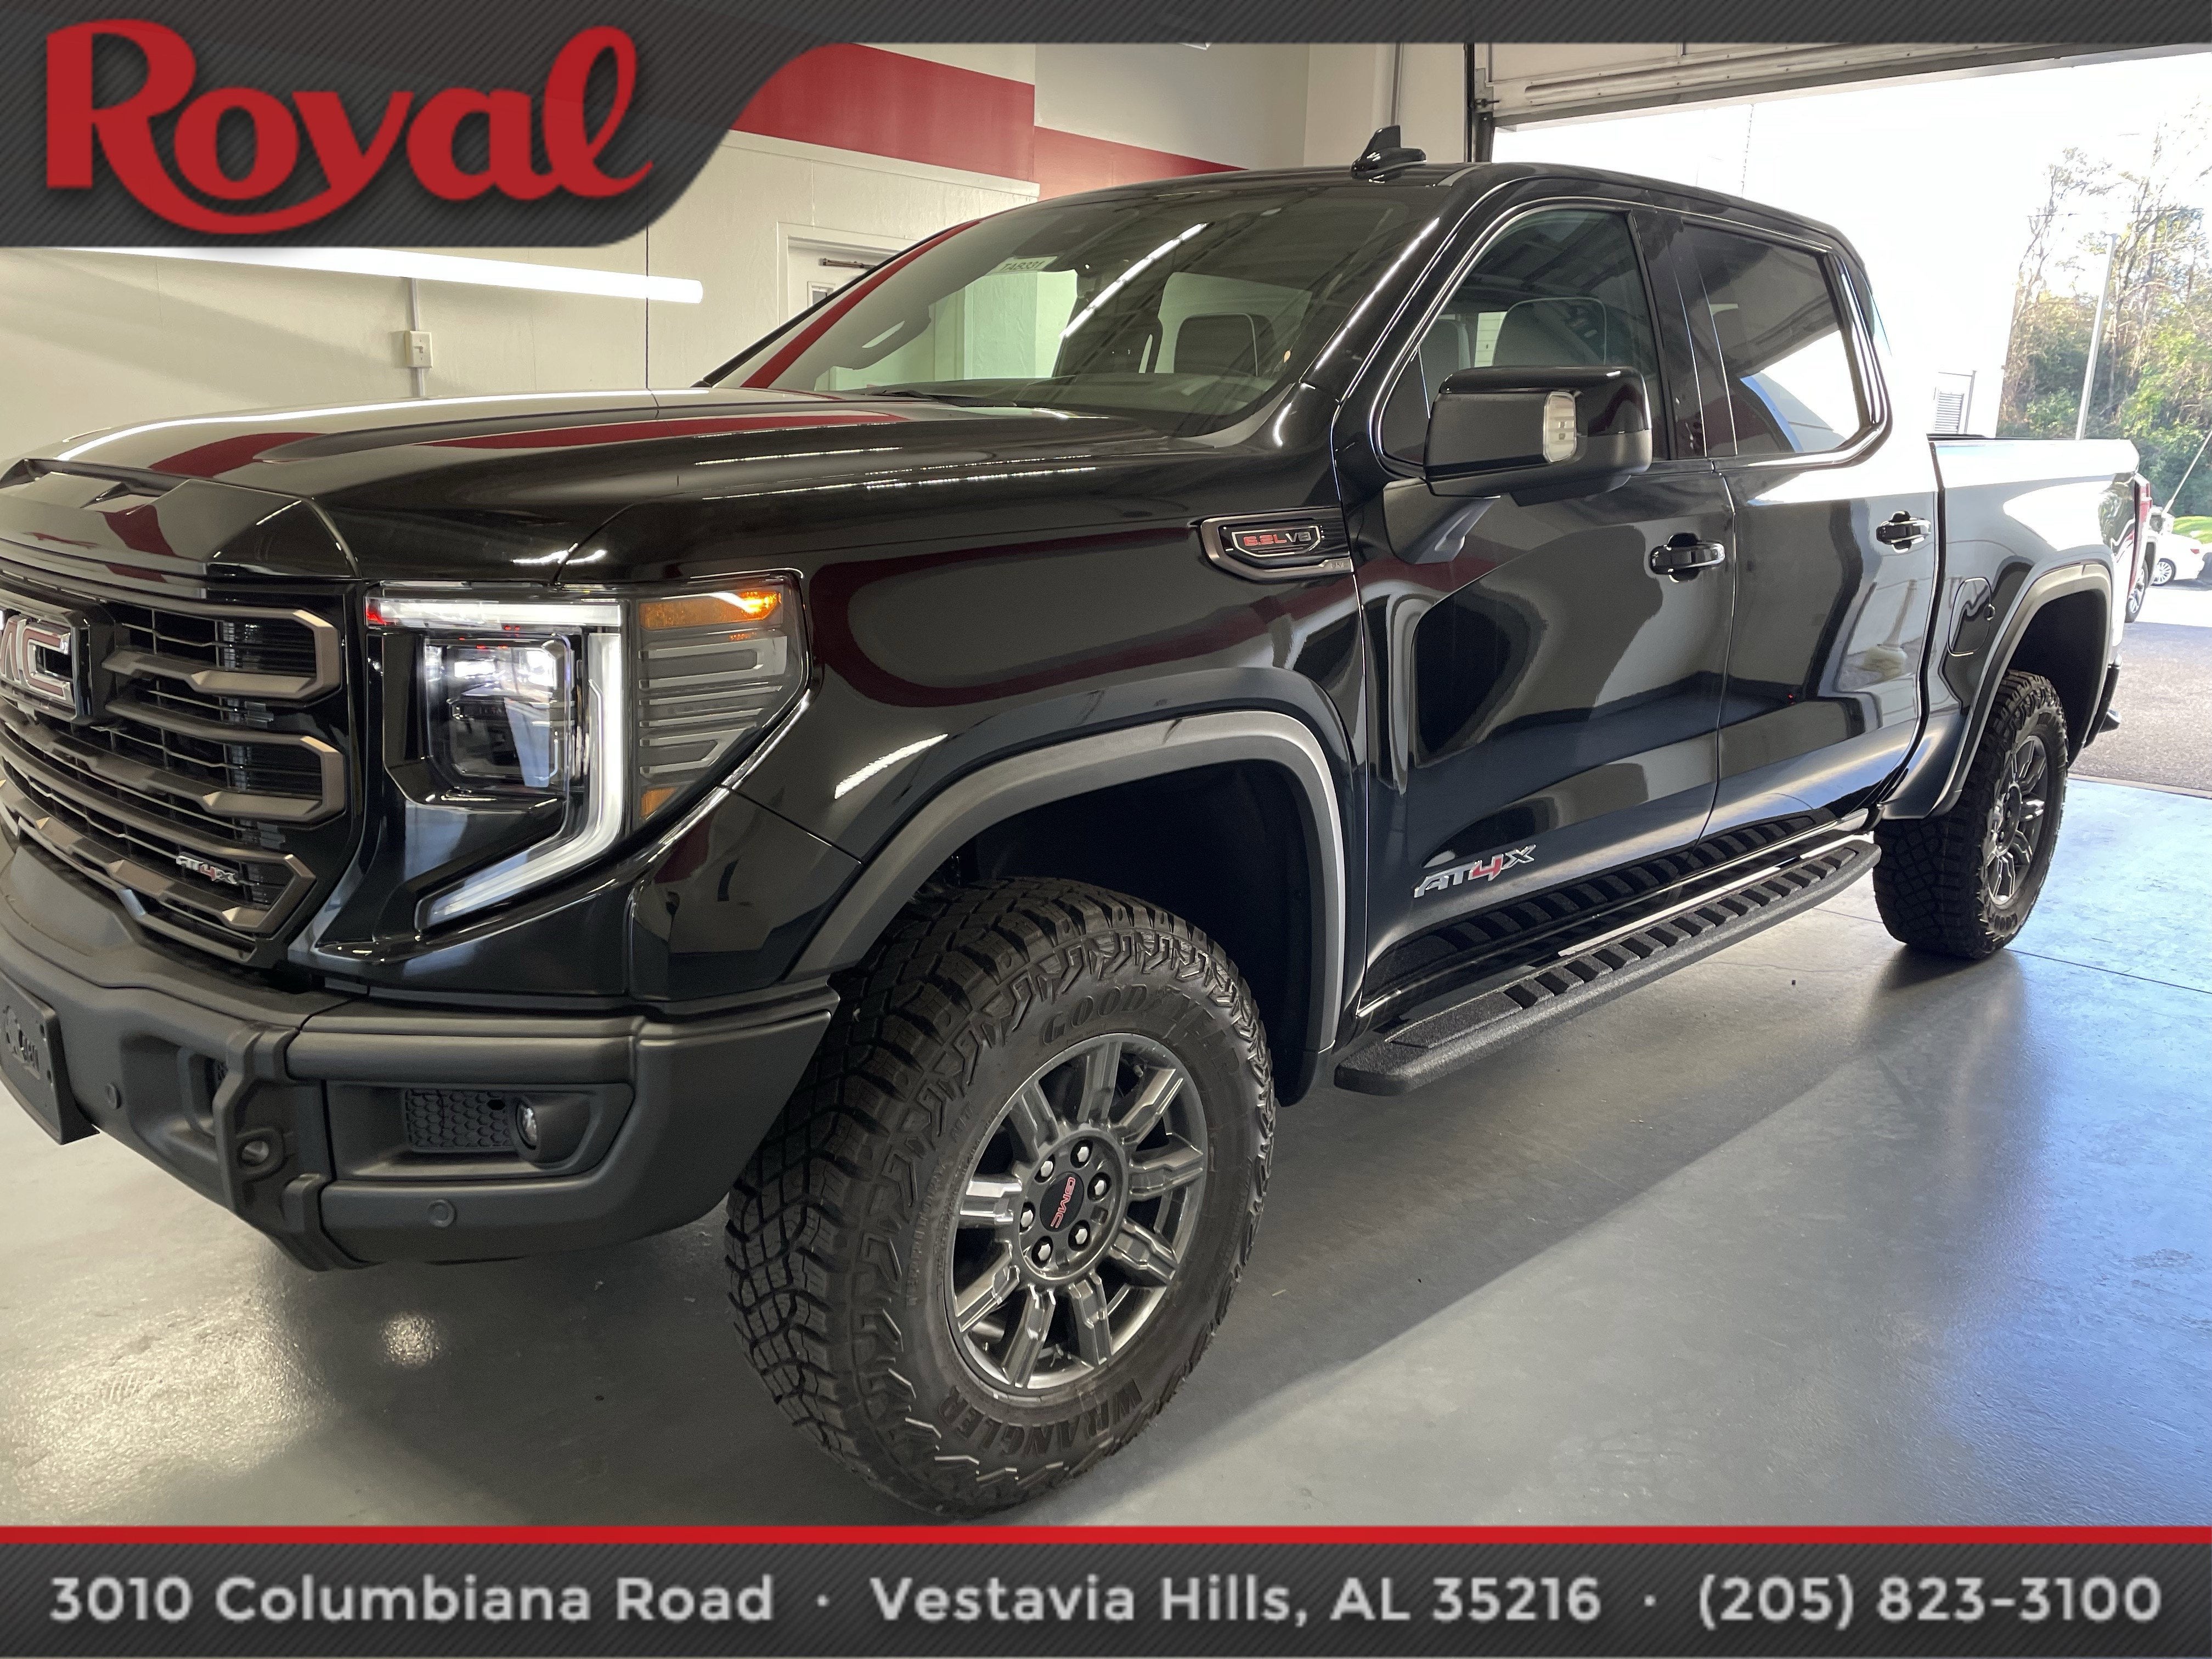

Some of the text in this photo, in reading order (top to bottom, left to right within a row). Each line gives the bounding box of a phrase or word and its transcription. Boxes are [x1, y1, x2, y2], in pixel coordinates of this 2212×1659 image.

[1414, 844, 1536, 898] AT4X
[1050, 1176, 1076, 1228] GMC
[938, 1378, 1143, 1457] WRANGLER
